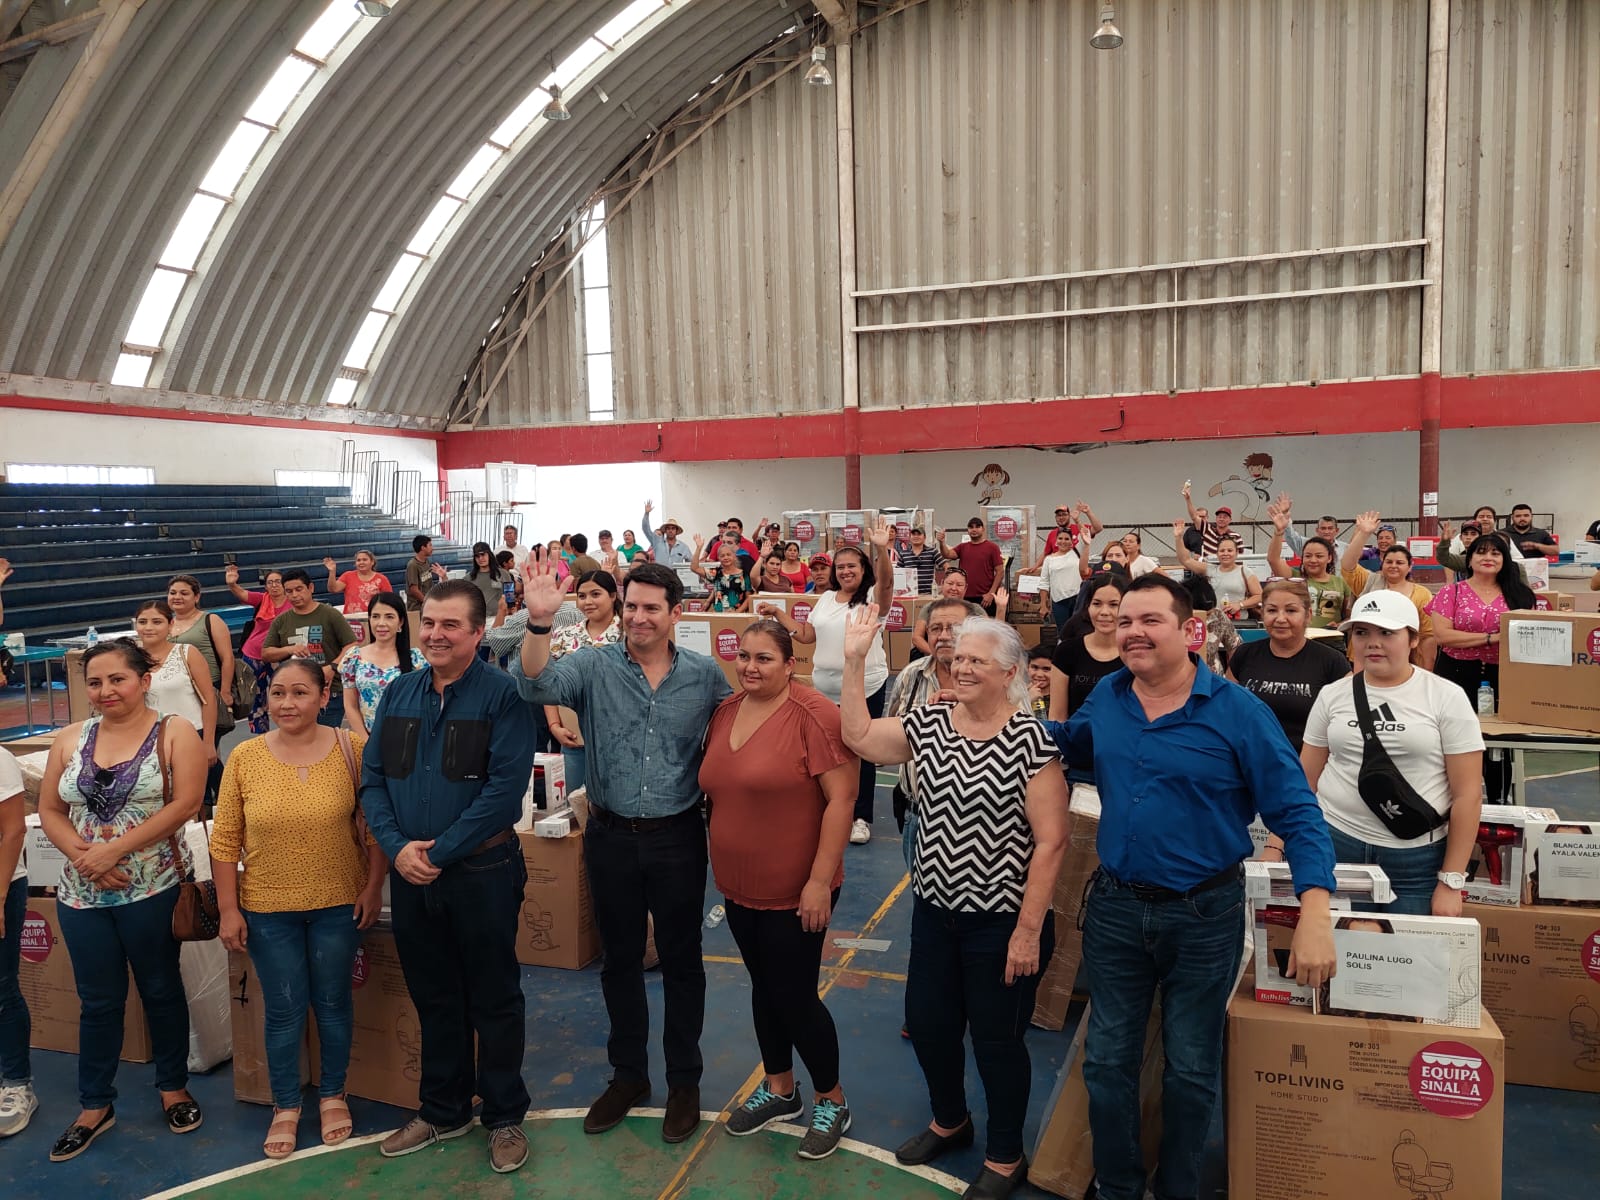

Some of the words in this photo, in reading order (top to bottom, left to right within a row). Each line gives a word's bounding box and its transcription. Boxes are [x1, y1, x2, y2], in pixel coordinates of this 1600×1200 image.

[1259, 680, 1312, 698] PATRONA
[1347, 720, 1406, 732] adas
[1553, 842, 1583, 850] BLANCA
[1346, 951, 1385, 962] PAULINA
[1387, 955, 1413, 965] LUGO
[1483, 952, 1531, 965] LIVING
[1346, 961, 1372, 970] SOLIS
[1254, 1070, 1345, 1091] TOPLIVING
[1421, 1065, 1481, 1082] EQUIPA
[1270, 1090, 1295, 1100] HOME
[1297, 1094, 1329, 1104] STUDIO
